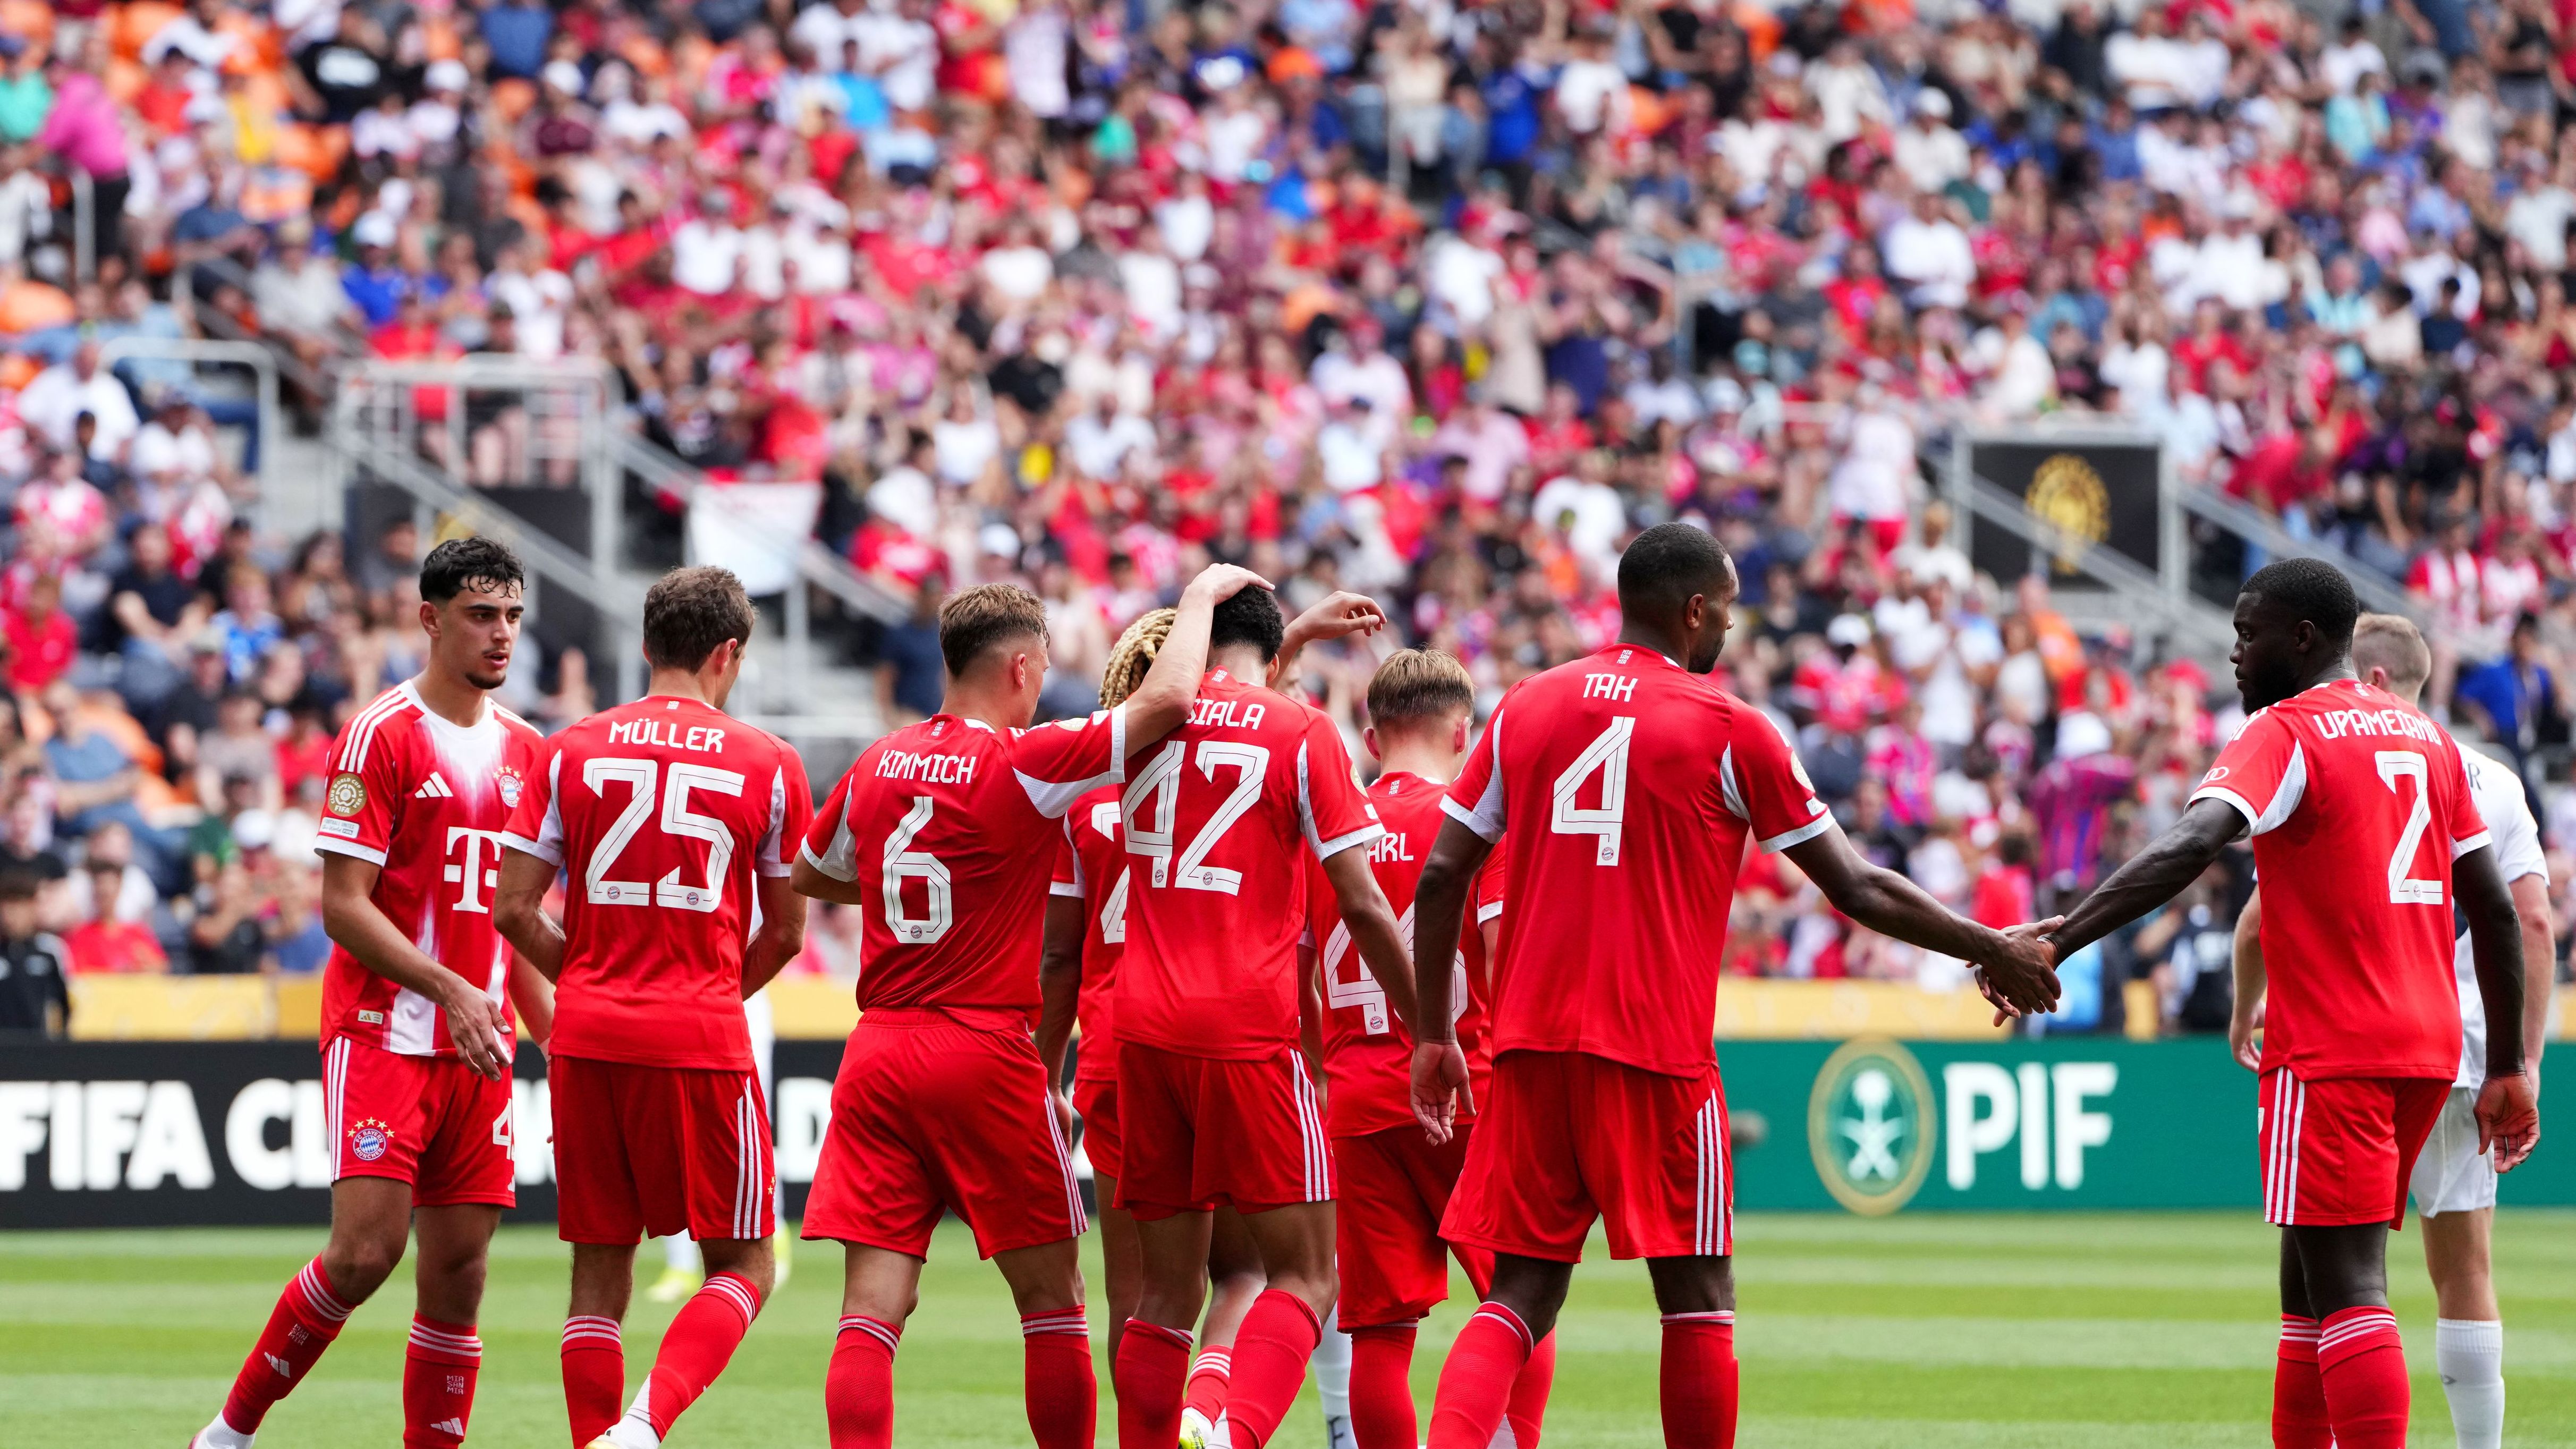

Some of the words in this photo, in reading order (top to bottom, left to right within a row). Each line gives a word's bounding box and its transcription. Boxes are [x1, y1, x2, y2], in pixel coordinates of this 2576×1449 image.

[1583, 673, 1639, 702] TAH
[608, 718, 725, 753] MÜLLER
[2313, 709, 2442, 746] UPAMECANO
[333, 777, 351, 789] WORLD
[351, 779, 361, 789] CUP
[875, 749, 977, 783] KIMMICH
[335, 805, 351, 814] FIFA
[352, 798, 362, 808] USA
[1551, 716, 1636, 866] 4
[583, 758, 745, 913] 25
[1121, 741, 1270, 896] 42
[2375, 751, 2443, 905] 2
[1367, 832, 1414, 863] ARL
[883, 796, 952, 944] 6
[1324, 901, 1468, 1035] 4
[0, 1080, 215, 1191] FIFA
[363, 1131, 384, 1143] BAYERN
[493, 1098, 515, 1162] 4
[1943, 1062, 2119, 1190] PIF
